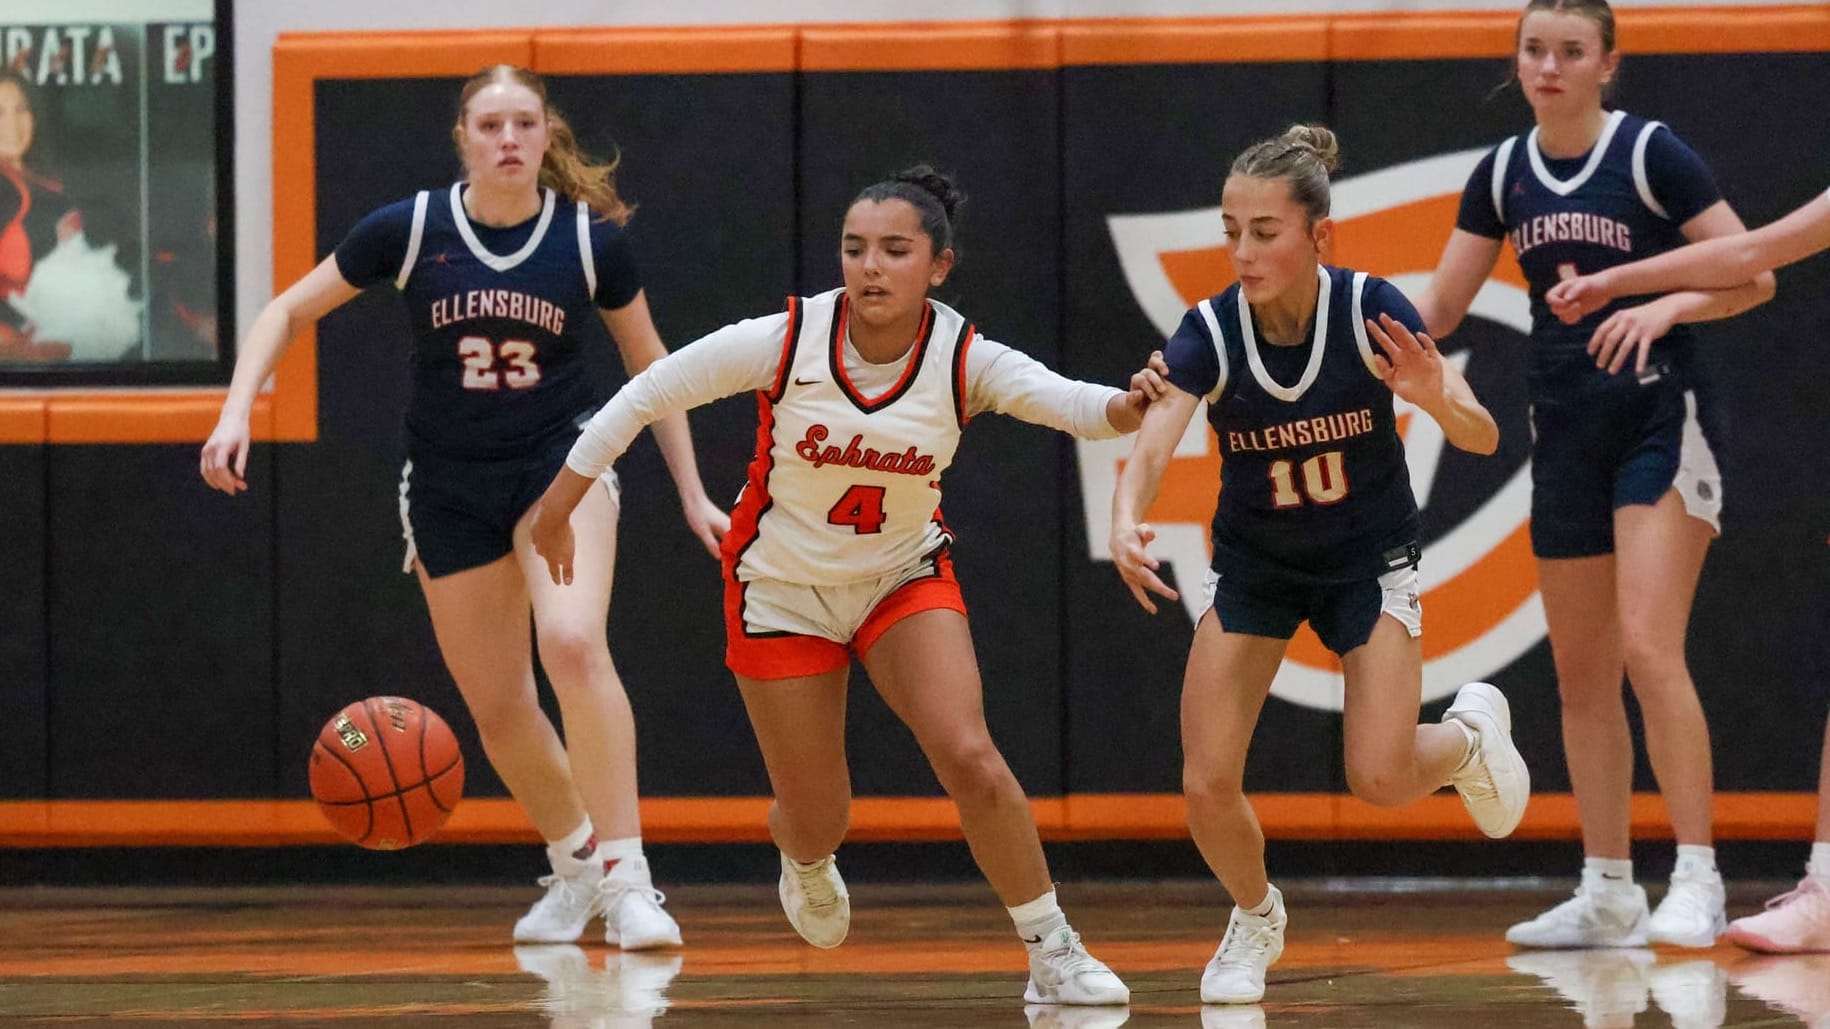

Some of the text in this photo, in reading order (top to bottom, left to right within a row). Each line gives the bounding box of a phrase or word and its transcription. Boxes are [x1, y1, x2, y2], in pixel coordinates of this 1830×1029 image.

[0, 26, 123, 86] RATA
[431, 289, 566, 336] ELLENSBURG
[457, 334, 542, 391] 23
[795, 423, 936, 477] Ephrata
[1229, 408, 1374, 453] ELLENSBURG
[1268, 450, 1351, 509] 10
[827, 484, 887, 535] 4
